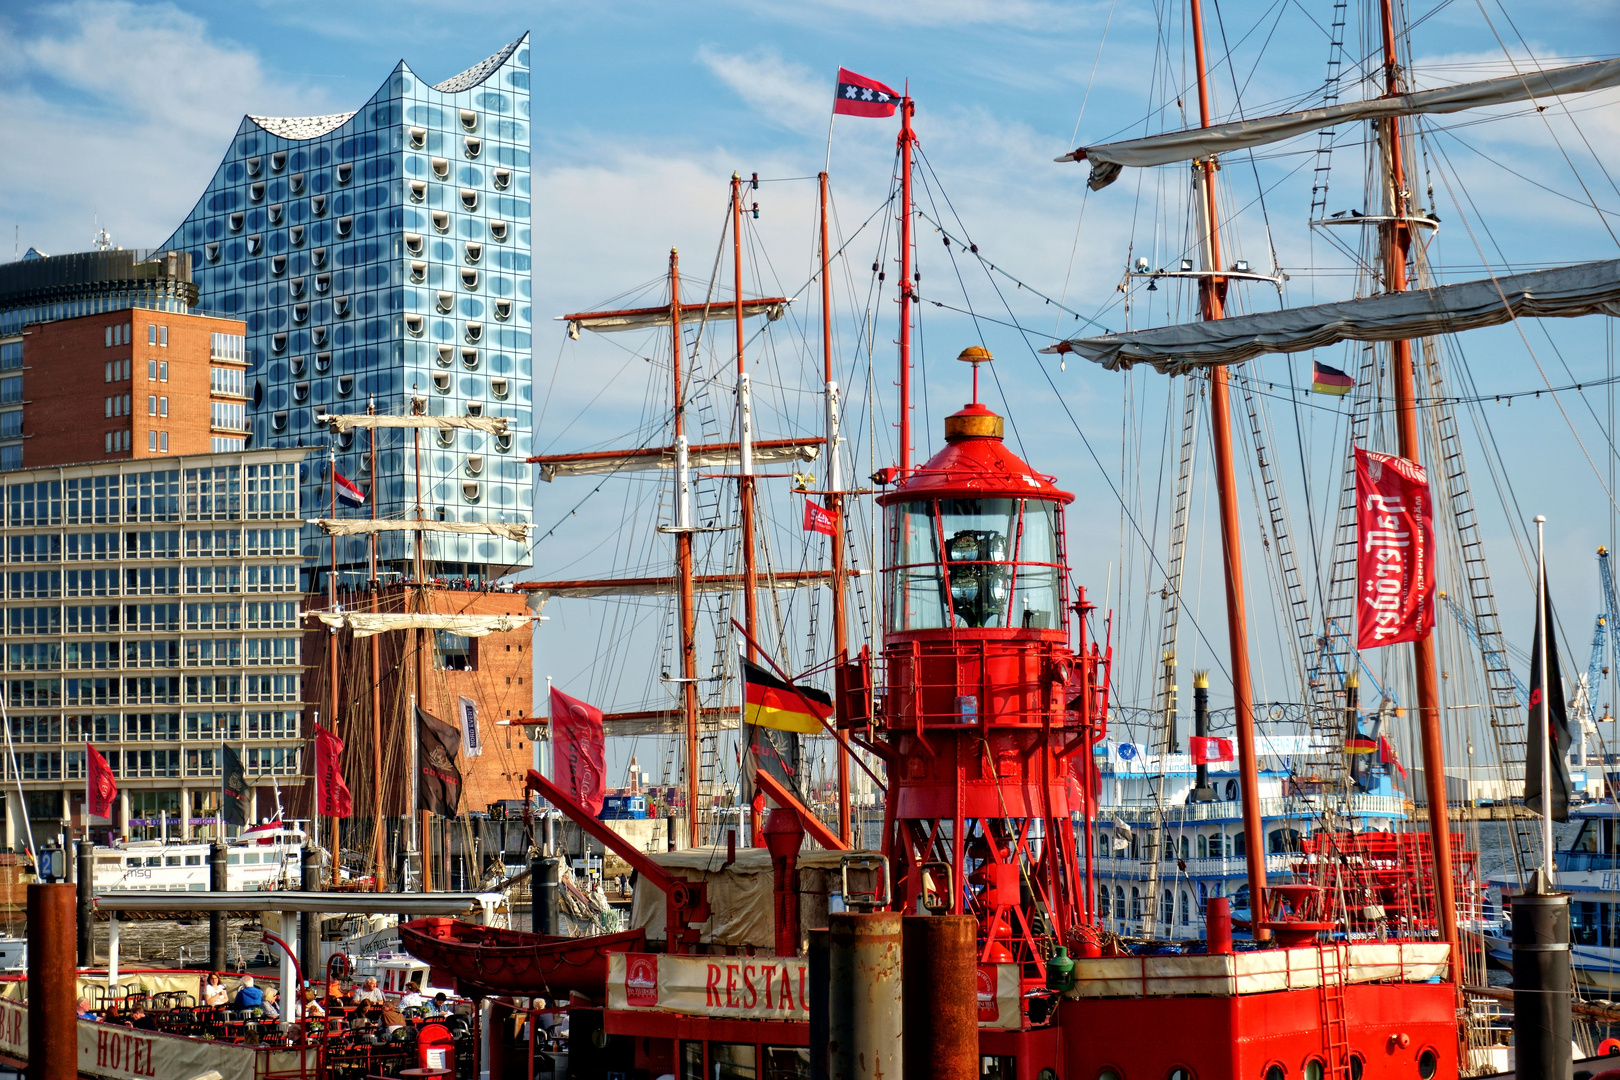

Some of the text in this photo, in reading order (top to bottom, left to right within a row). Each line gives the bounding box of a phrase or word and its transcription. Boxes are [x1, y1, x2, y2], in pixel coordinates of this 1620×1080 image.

[466, 707, 477, 748] NORD EVENT
[751, 744, 796, 777] CUND
[42, 854, 51, 874] 2
[126, 869, 152, 879] msg
[1404, 930, 1440, 938] HAMURG
[97, 1029, 156, 1077] HOTEL
